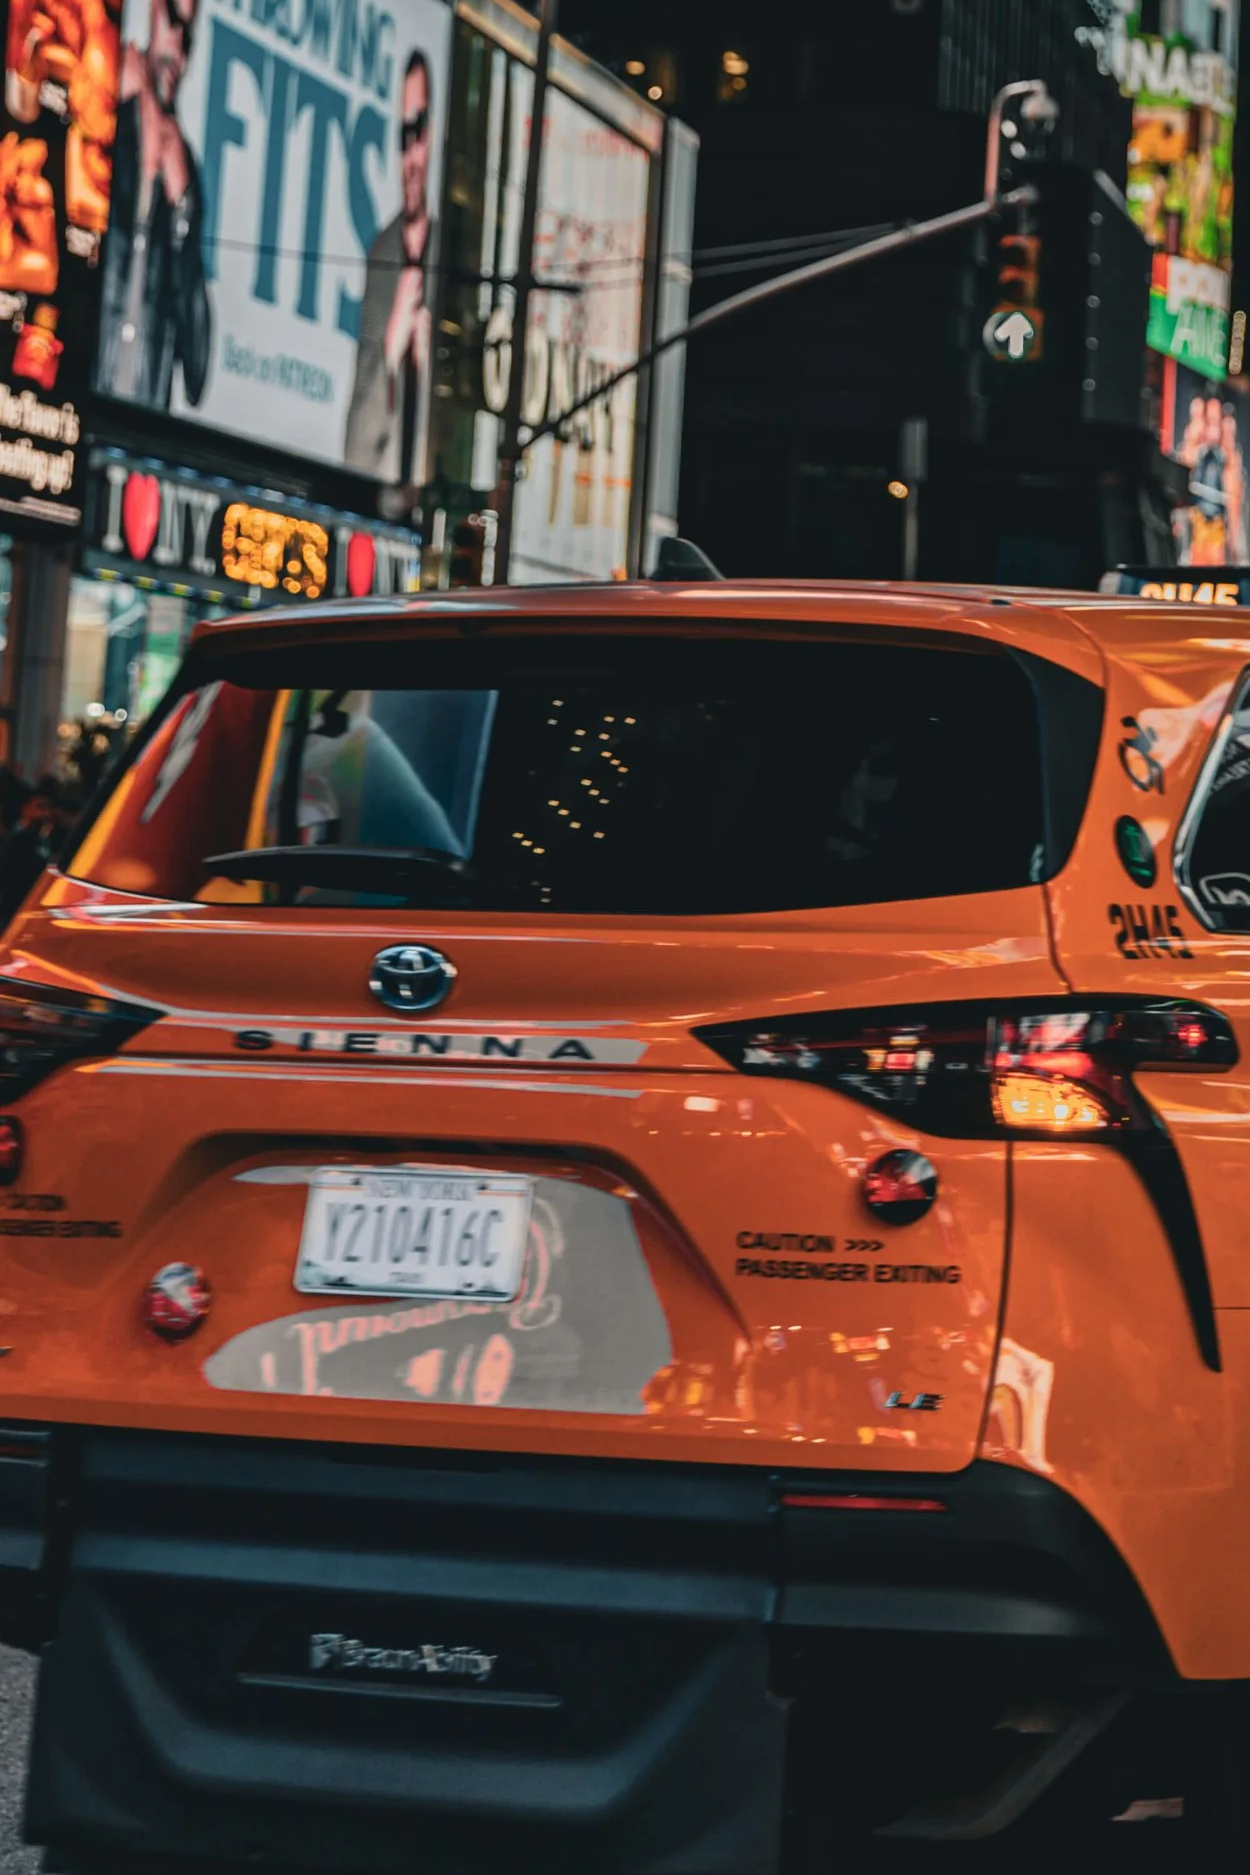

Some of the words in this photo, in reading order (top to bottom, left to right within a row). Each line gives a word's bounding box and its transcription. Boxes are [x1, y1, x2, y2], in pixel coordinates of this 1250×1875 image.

[202, 13, 389, 343] FITS
[105, 465, 127, 553] I
[153, 479, 221, 575] NY
[1107, 903, 1196, 960] 2H45
[233, 1029, 595, 1060] SIENNA
[324, 1202, 504, 1268] Y210416C
[736, 1231, 834, 1252] CAUTION
[735, 1258, 869, 1282] PASSENGER
[873, 1264, 962, 1284] EXITING
[883, 1390, 947, 1411] LE
